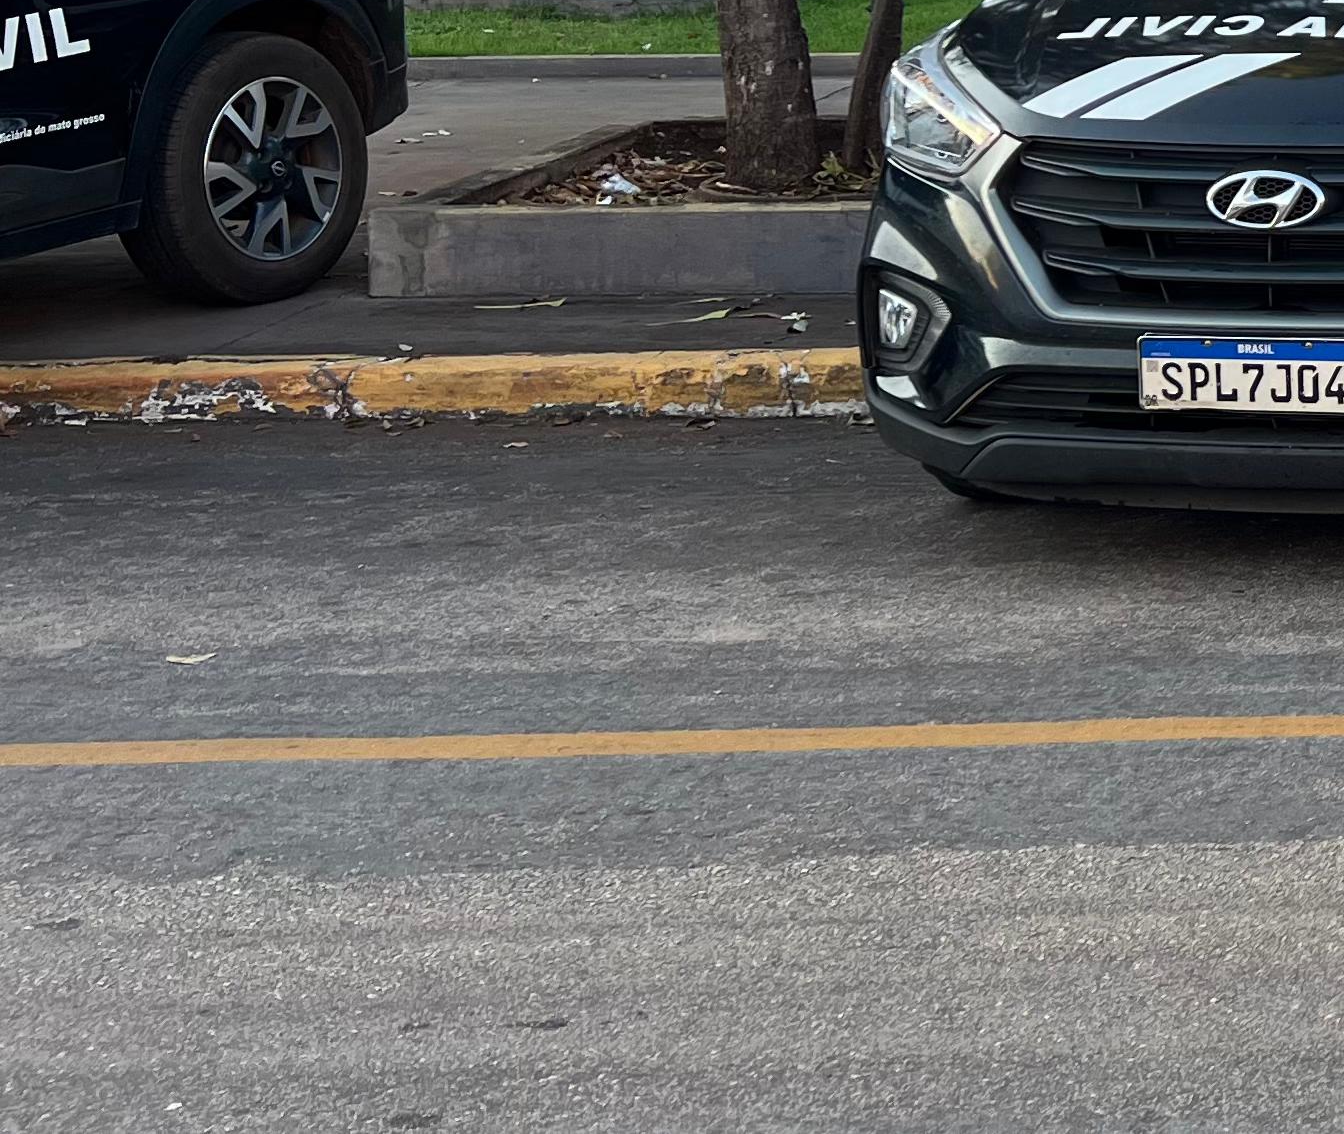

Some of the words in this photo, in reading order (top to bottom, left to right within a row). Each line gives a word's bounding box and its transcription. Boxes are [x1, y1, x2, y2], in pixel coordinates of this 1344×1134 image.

[48, 119, 72, 133] mato
[73, 113, 105, 130] grosso
[1237, 343, 1275, 355] BRASIL
